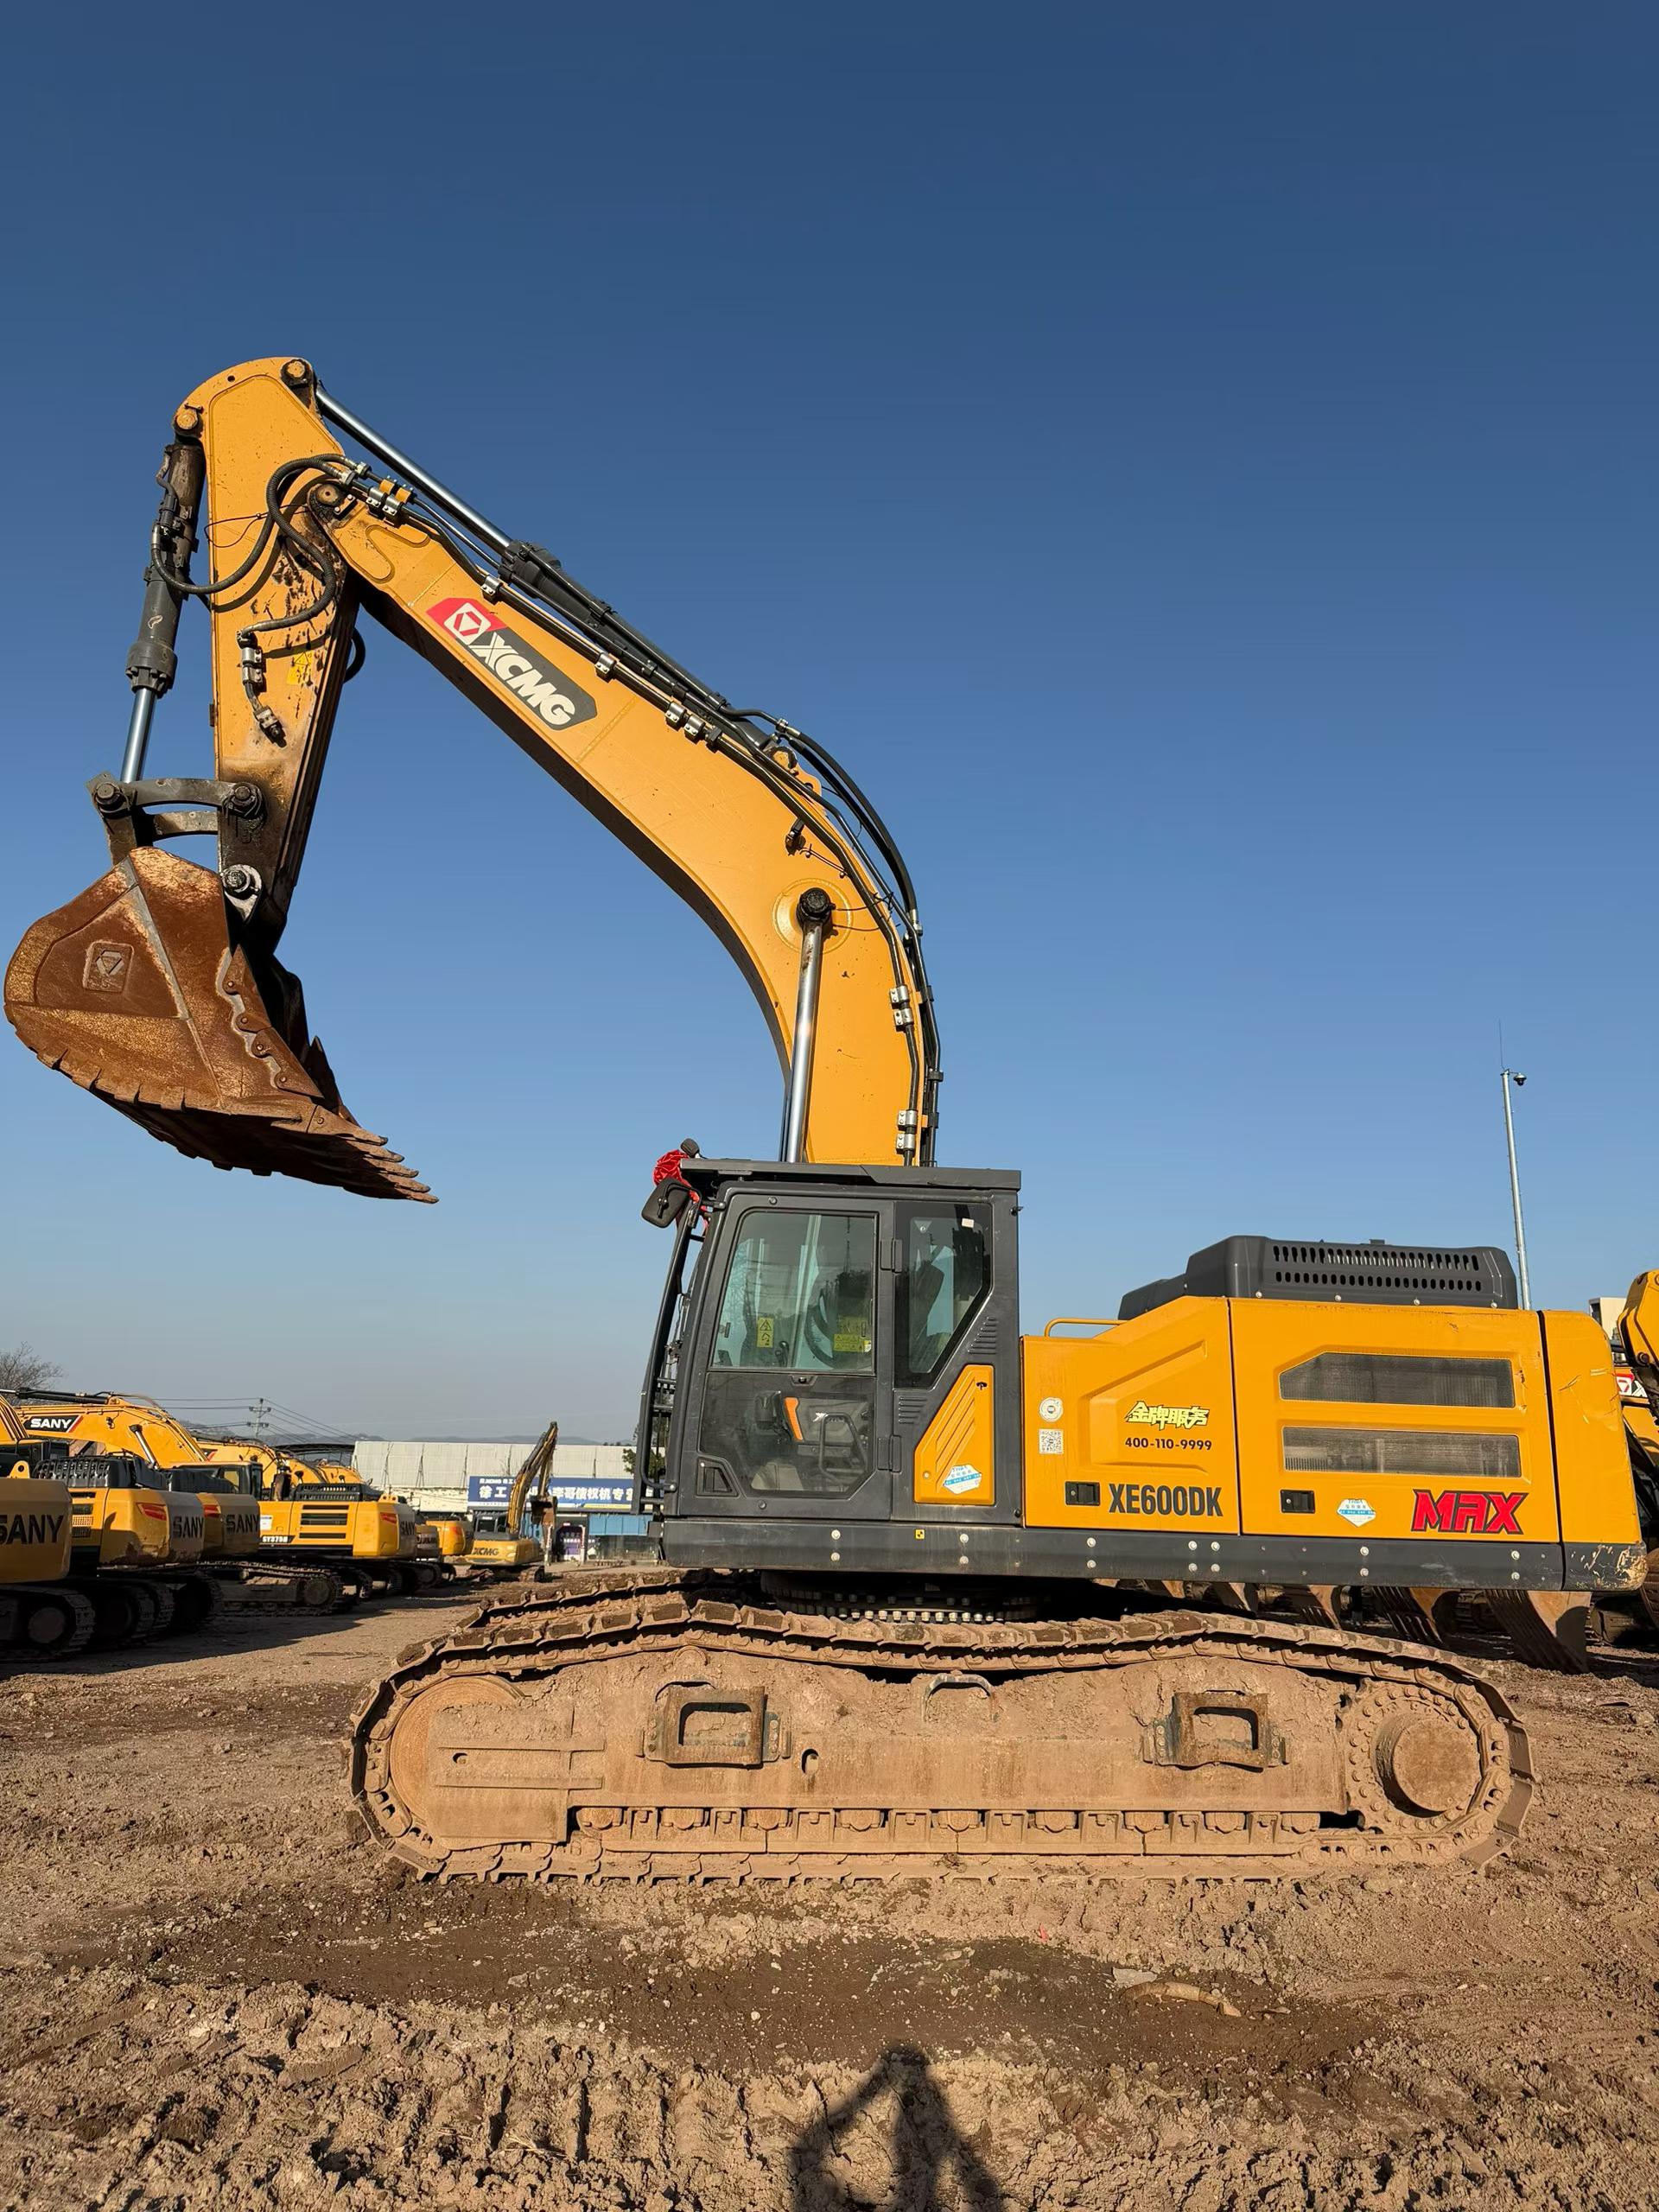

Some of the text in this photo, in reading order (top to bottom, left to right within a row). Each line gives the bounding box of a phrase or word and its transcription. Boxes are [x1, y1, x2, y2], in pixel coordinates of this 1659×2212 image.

[468, 632, 575, 725] XCMG
[30, 1418, 73, 1428] SANY
[1125, 1401, 1210, 1430] 金牌服务
[1125, 1437, 1212, 1451] 400-110-9999
[1109, 1483, 1224, 1517] XE600DK
[1411, 1489, 1529, 1535] MAX
[173, 1516, 204, 1538] SANY
[226, 1514, 259, 1534] SANY
